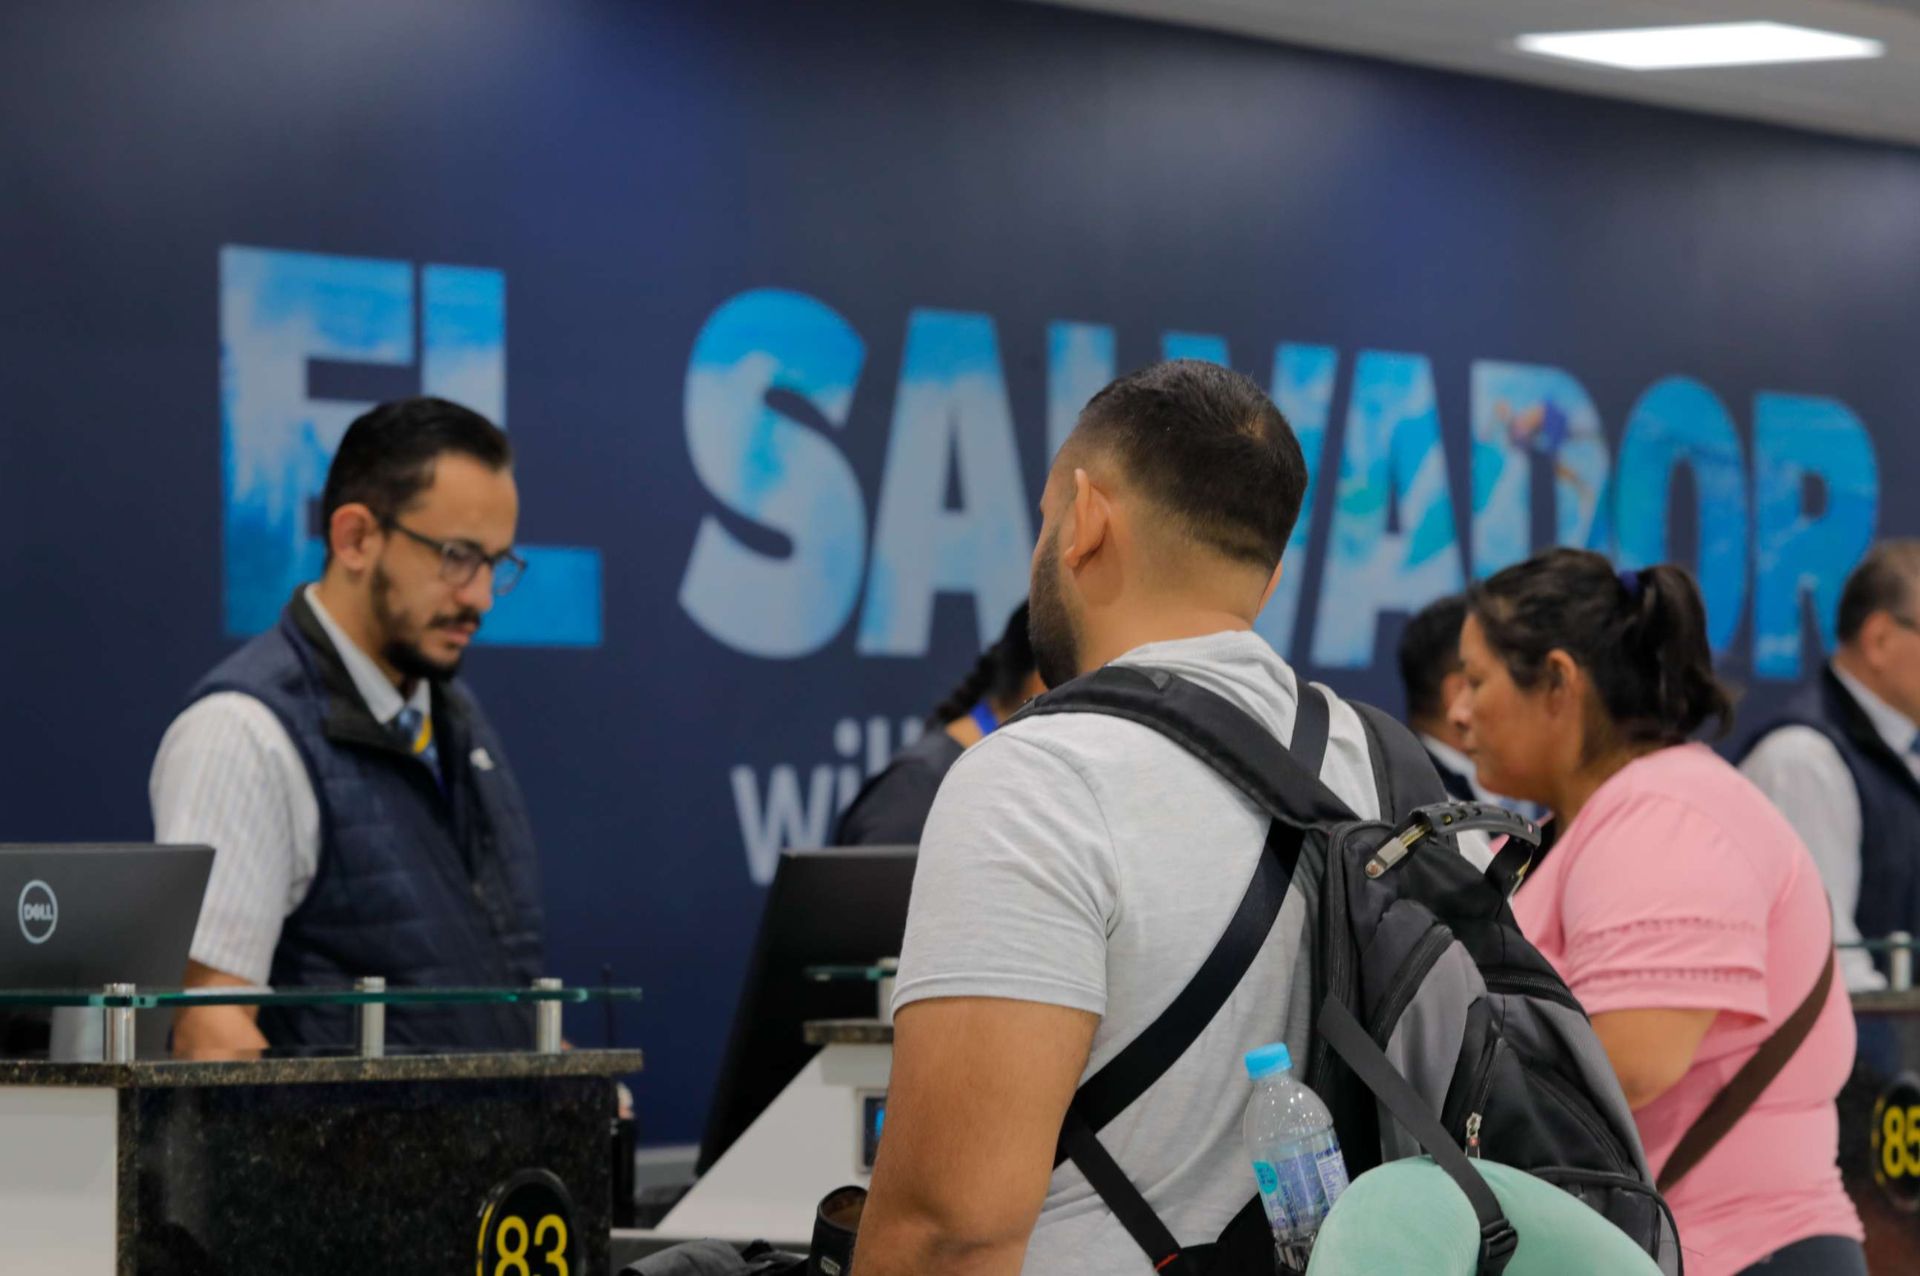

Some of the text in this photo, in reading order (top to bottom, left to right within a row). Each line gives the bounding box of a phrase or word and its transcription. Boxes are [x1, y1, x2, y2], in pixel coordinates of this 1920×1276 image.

[23, 903, 53, 920] DELL
[1883, 1105, 1920, 1178] 85
[494, 1213, 569, 1276] 83
